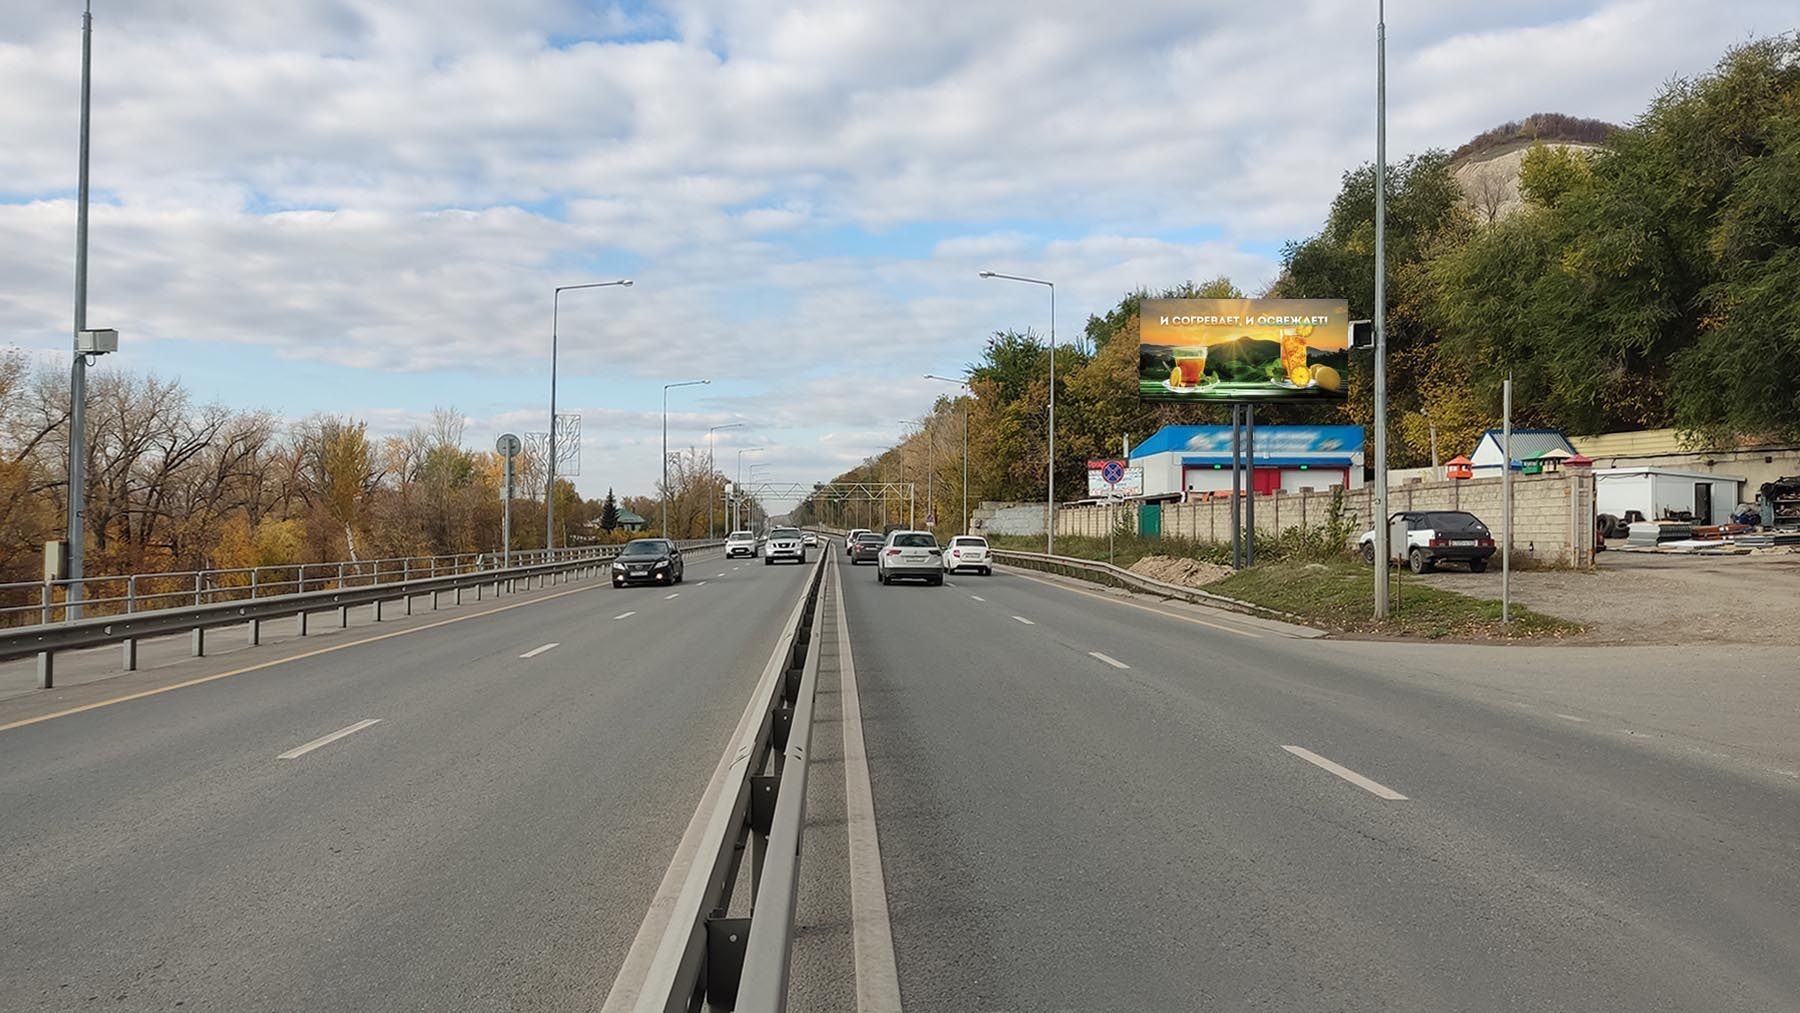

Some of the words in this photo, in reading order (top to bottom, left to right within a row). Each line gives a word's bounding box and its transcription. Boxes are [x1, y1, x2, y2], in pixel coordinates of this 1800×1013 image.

[1160, 316, 1169, 326] И
[1172, 316, 1242, 327] СОГРЕВАЕТ,
[1246, 316, 1254, 326] И
[1257, 316, 1328, 326] ОСВЕЖАЕТ!
